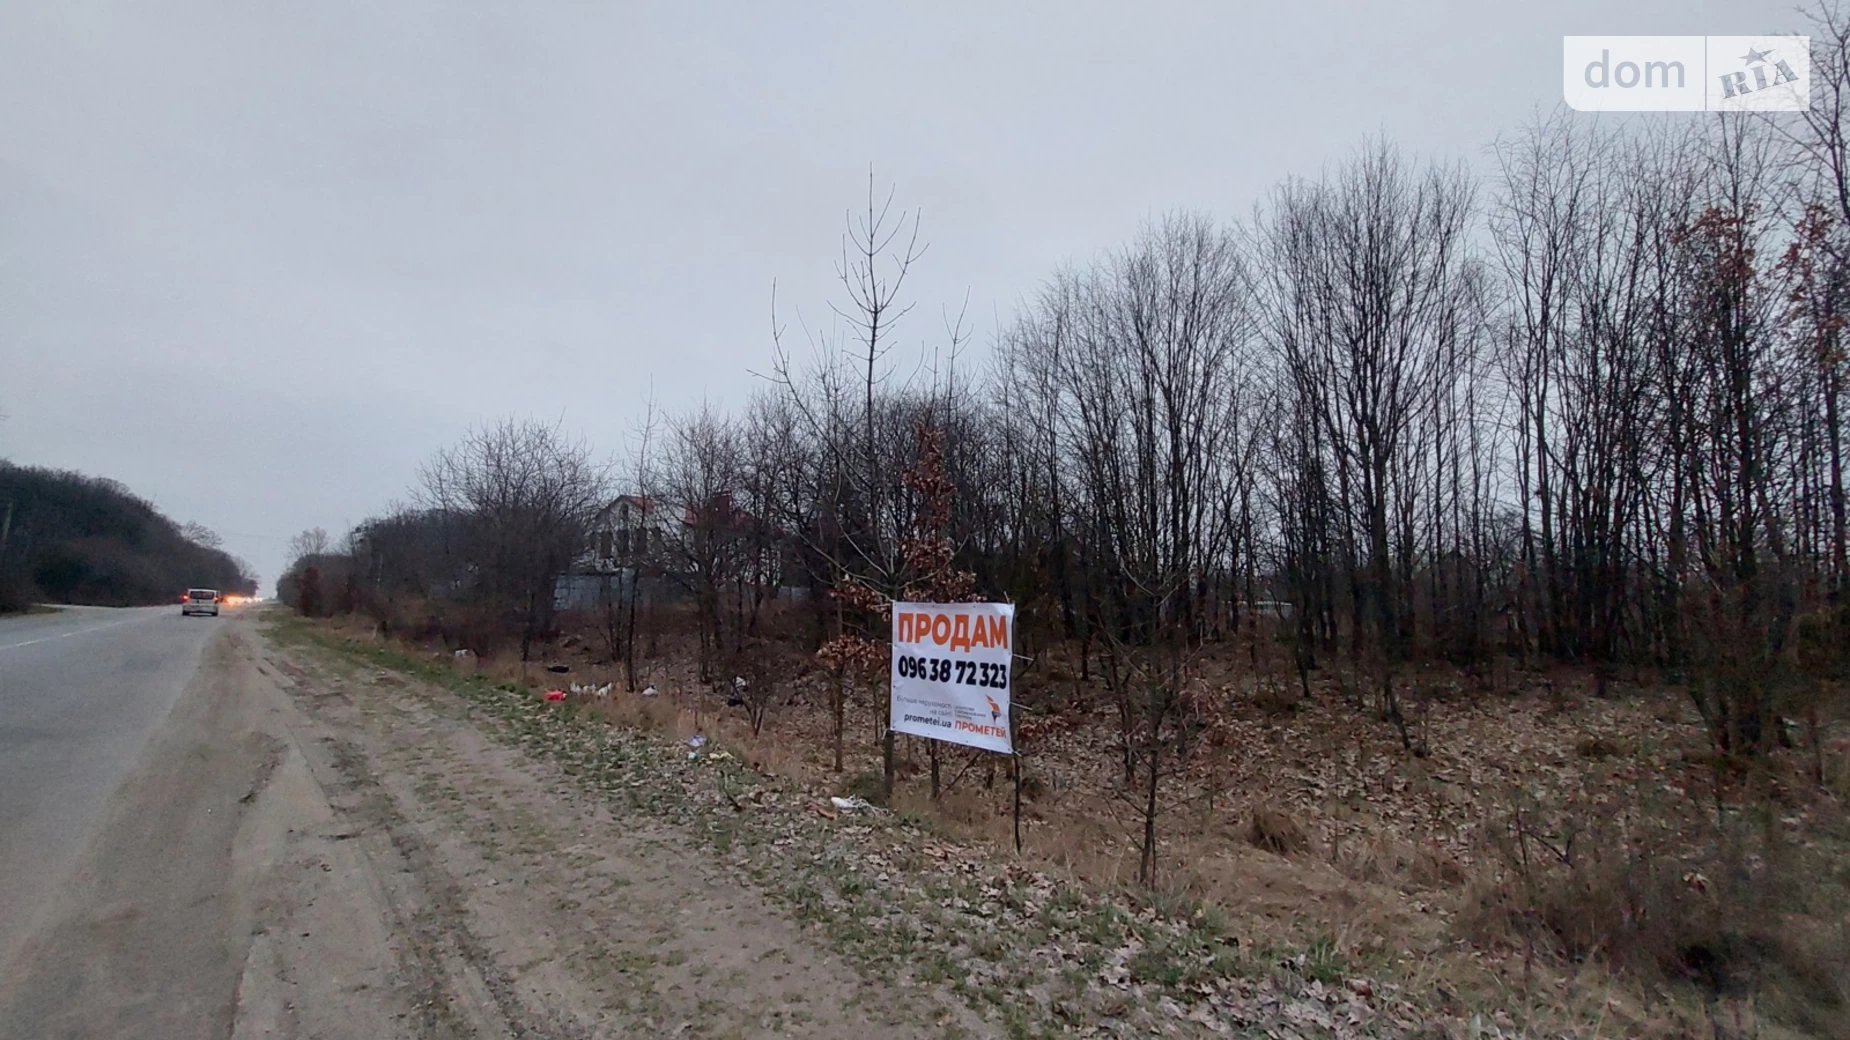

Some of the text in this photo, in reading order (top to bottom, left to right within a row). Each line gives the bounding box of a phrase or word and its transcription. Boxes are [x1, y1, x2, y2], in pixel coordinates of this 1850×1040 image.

[898, 613, 1008, 653] ПРОДАМ
[898, 655, 1007, 689] 096 38 72 323
[904, 714, 952, 728] prometei.ua
[954, 720, 1007, 738] ПРОМЕТЕЙ
